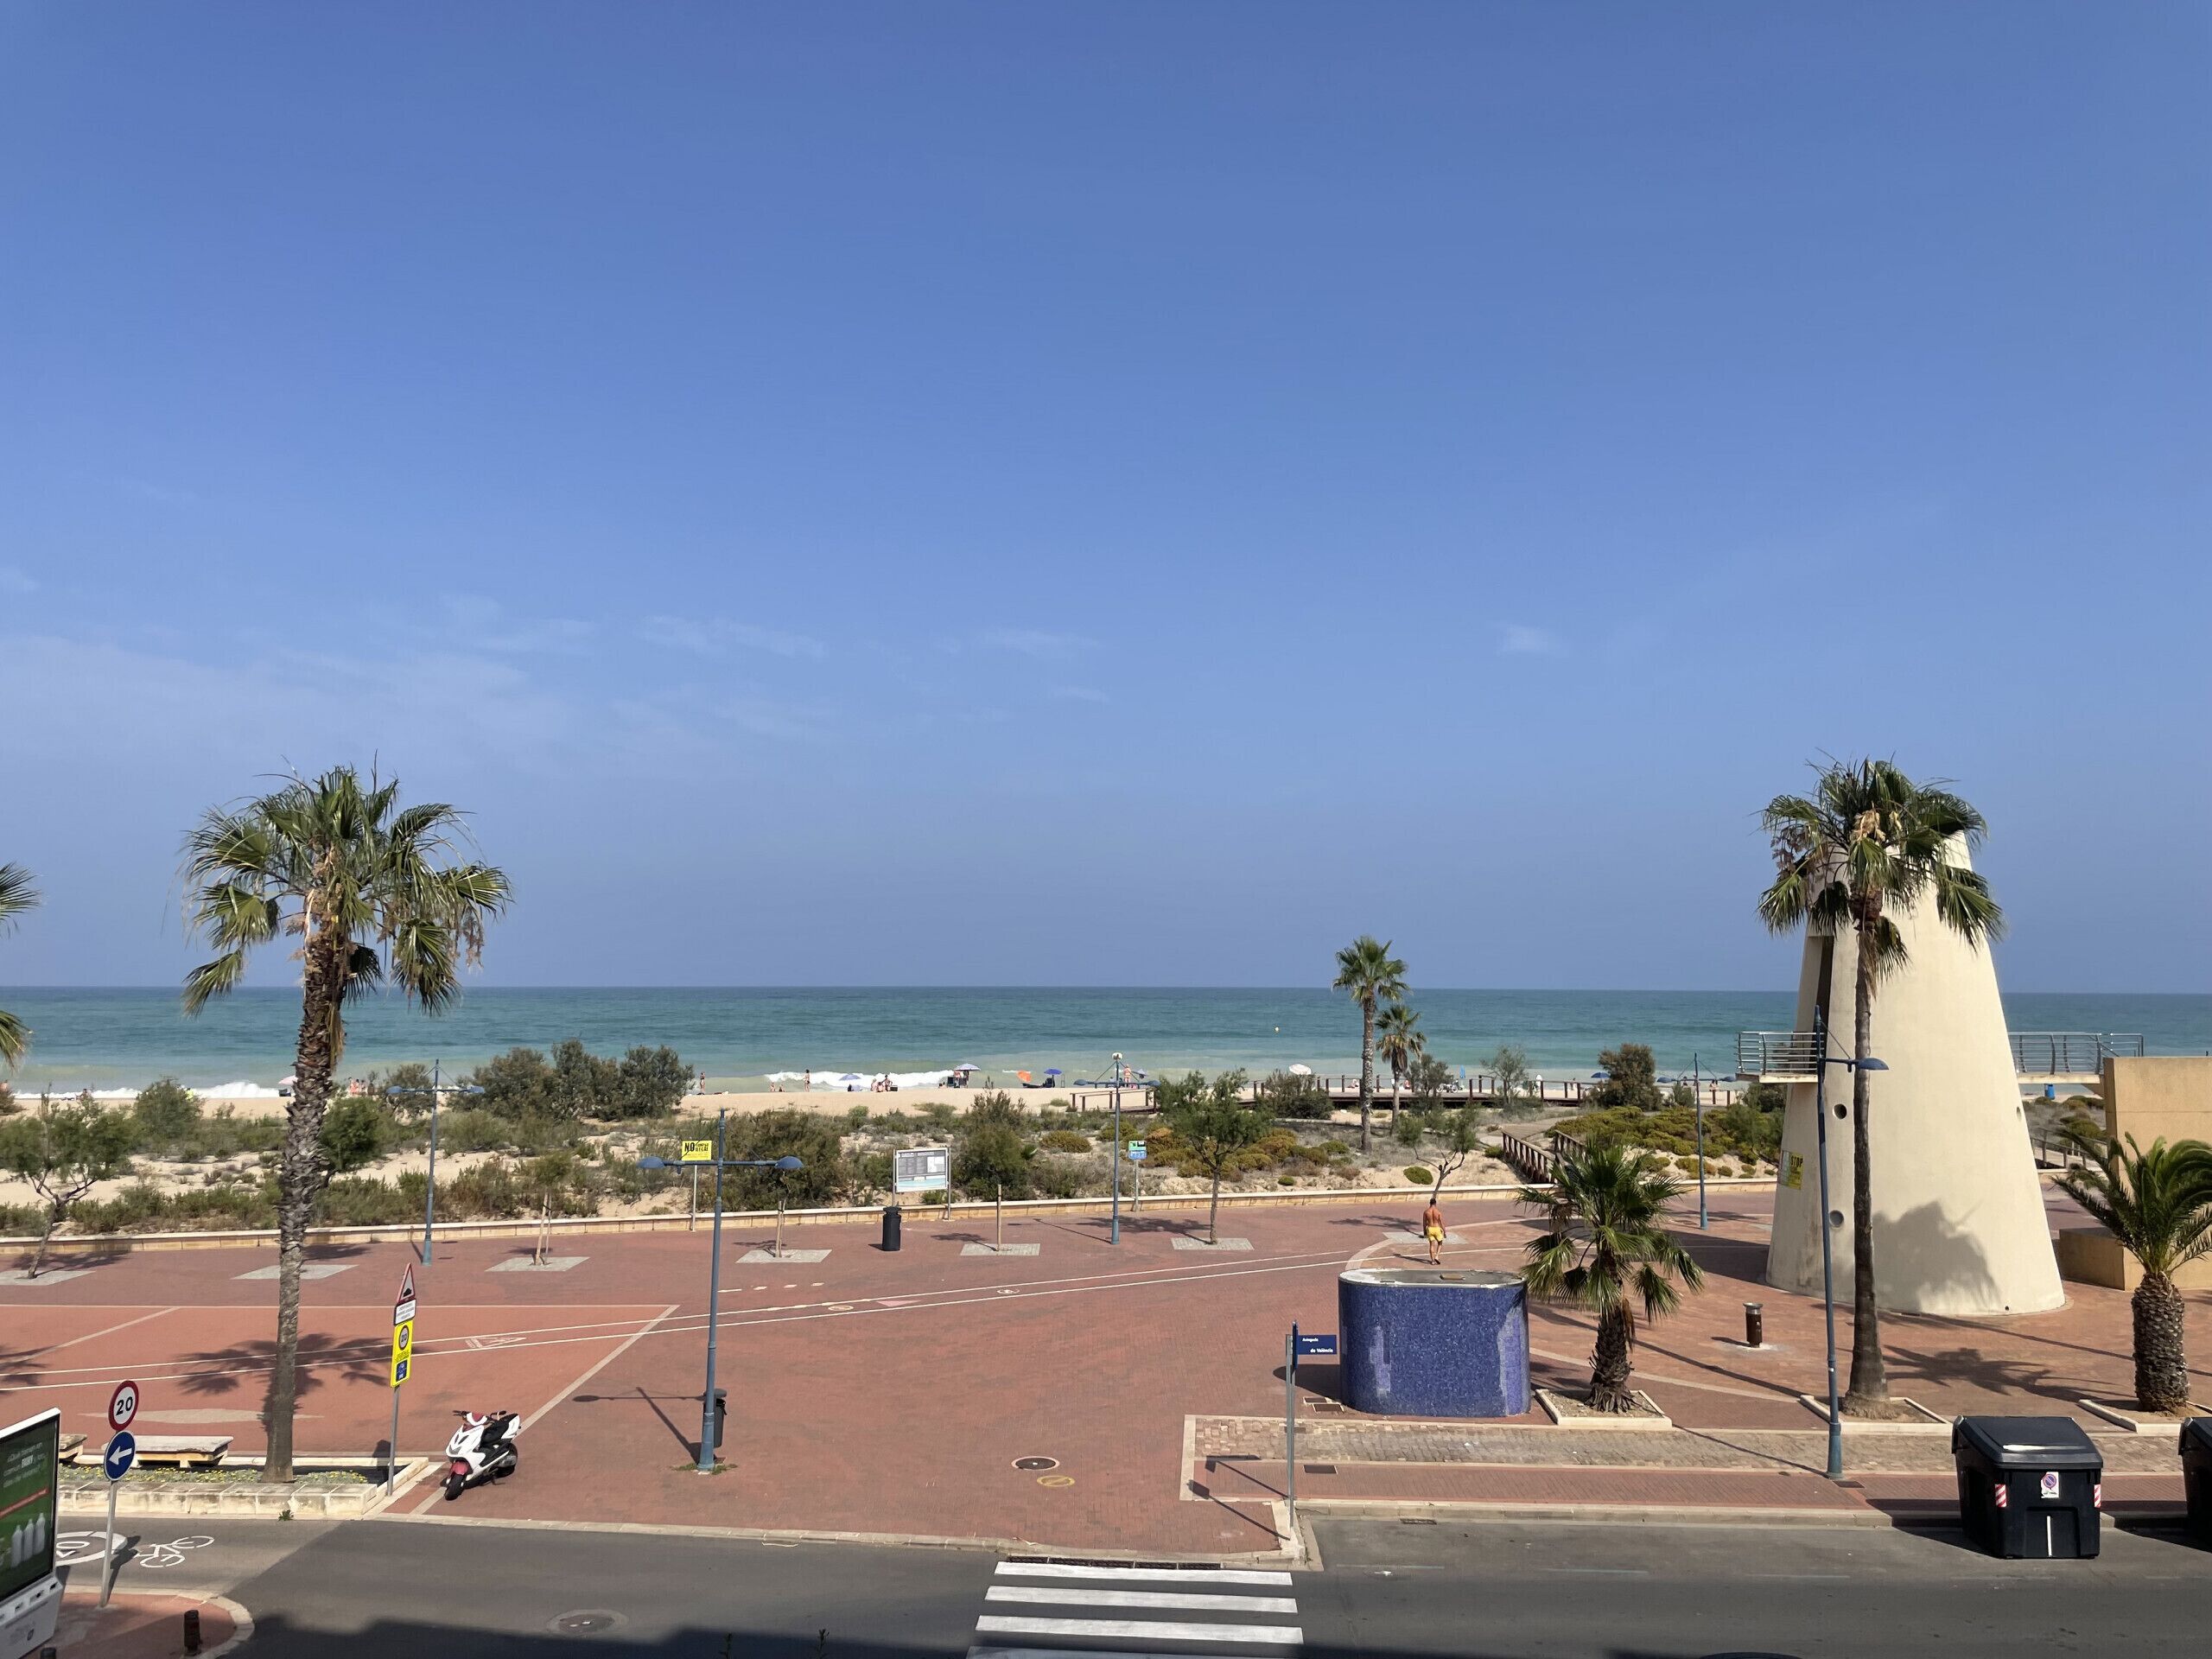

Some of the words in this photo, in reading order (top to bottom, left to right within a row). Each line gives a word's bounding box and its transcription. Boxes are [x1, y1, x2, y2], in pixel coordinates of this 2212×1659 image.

[684, 1142, 695, 1152] NO
[1790, 1154, 1803, 1167] STOP
[116, 1396, 133, 1416] 20
